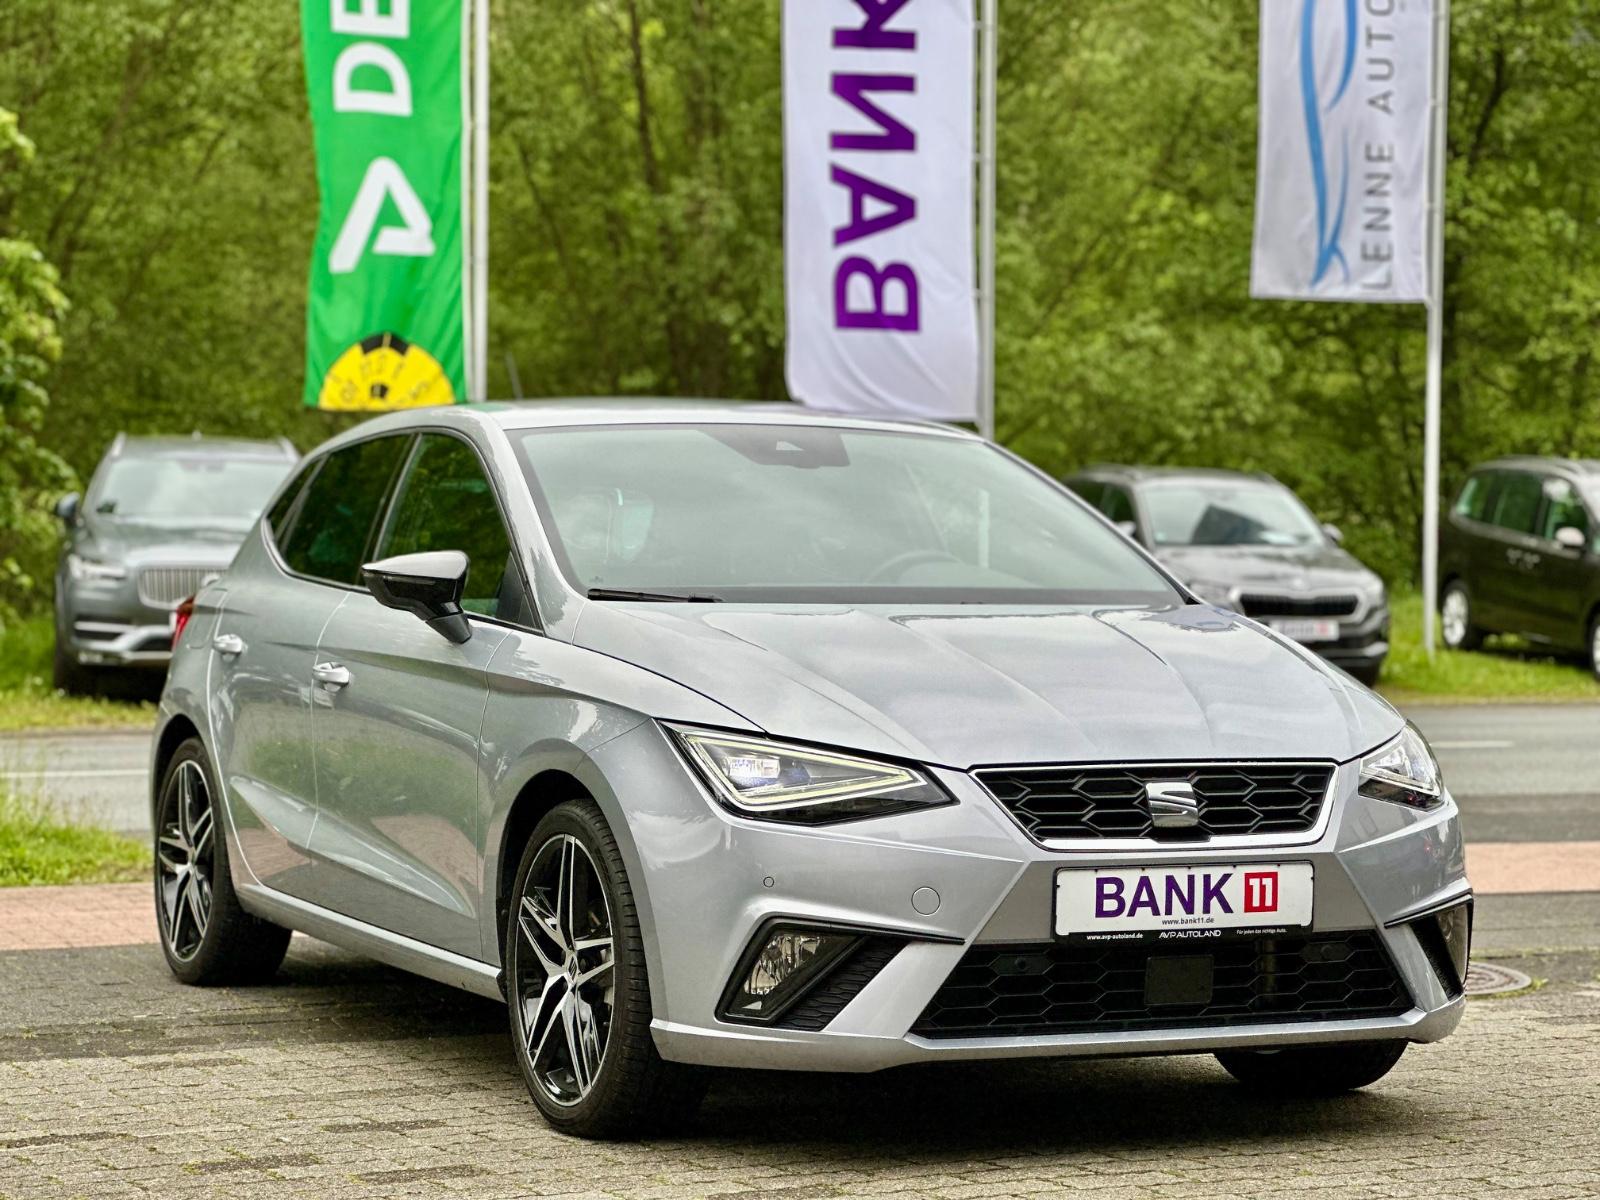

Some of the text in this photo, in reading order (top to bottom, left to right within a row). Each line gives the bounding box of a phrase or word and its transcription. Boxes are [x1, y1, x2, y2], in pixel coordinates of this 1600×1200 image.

[1361, 143, 1395, 291] LENNE
[1095, 872, 1274, 918] BANK 11
[1161, 916, 1215, 926] www.bank11.de
